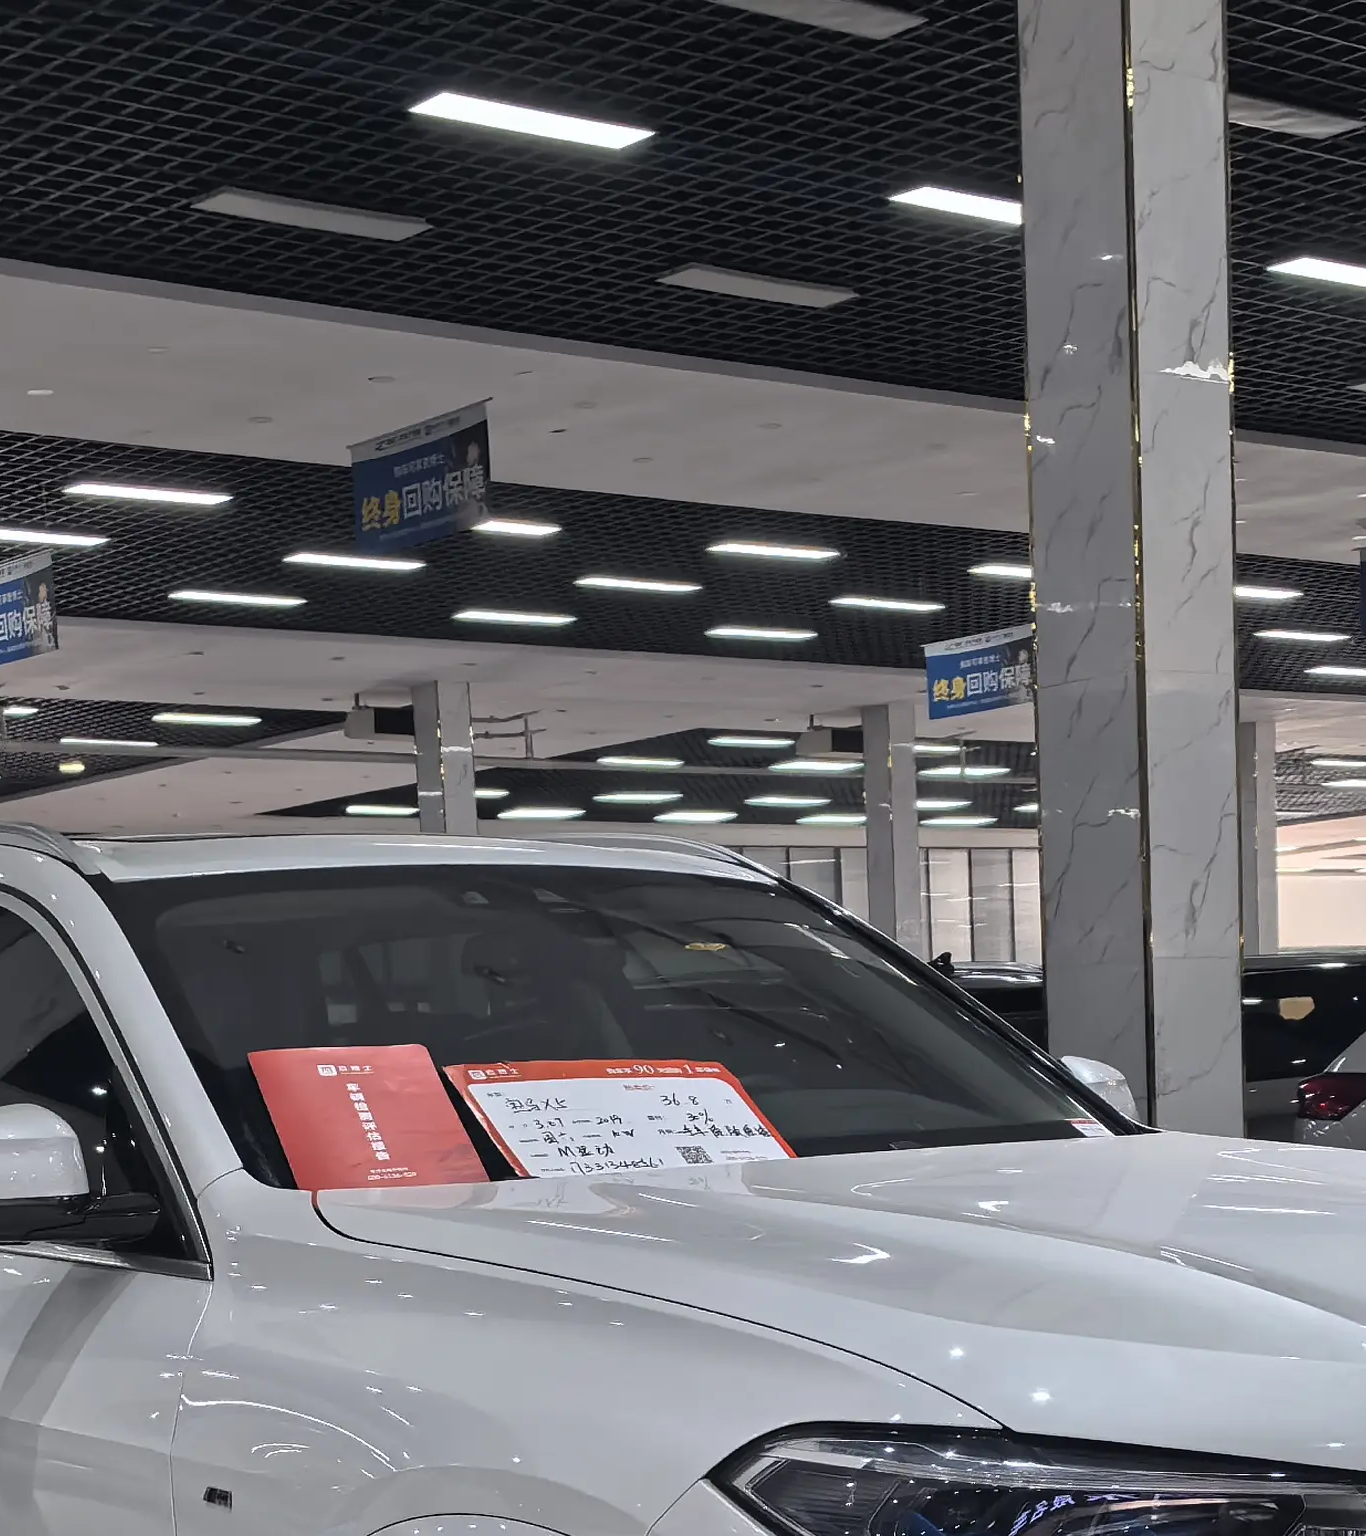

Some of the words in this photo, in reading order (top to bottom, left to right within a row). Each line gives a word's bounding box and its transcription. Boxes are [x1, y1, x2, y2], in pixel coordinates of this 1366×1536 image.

[361, 464, 486, 532] 终身回购保障
